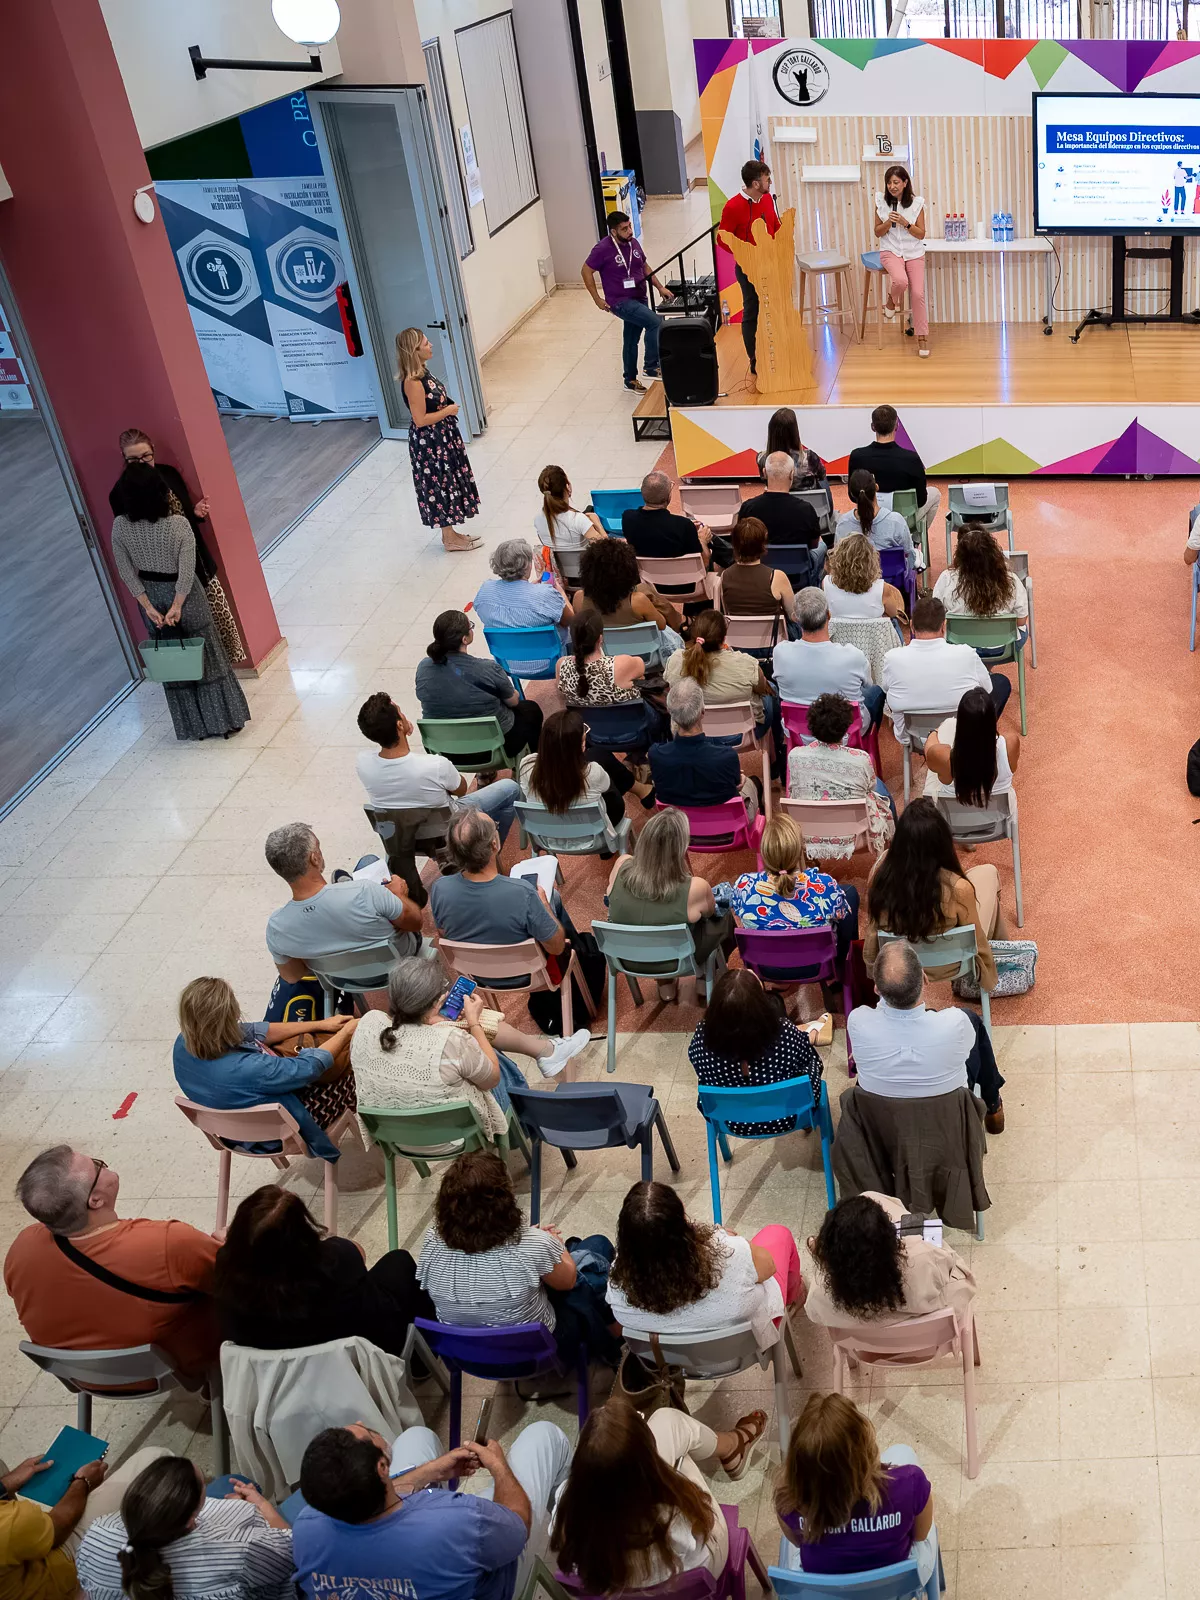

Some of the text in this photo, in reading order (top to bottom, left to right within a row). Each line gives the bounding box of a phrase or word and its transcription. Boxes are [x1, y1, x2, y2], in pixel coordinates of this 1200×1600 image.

[781, 55, 822, 75] CIFP TONY GALLARDO
[1056, 131, 1185, 144] Mesa Equipos Directivos:
[1108, 143, 1133, 151] liderazgo
[850, 1511, 902, 1533] GALLARDO
[311, 1571, 418, 1599] CALIFORNIA
